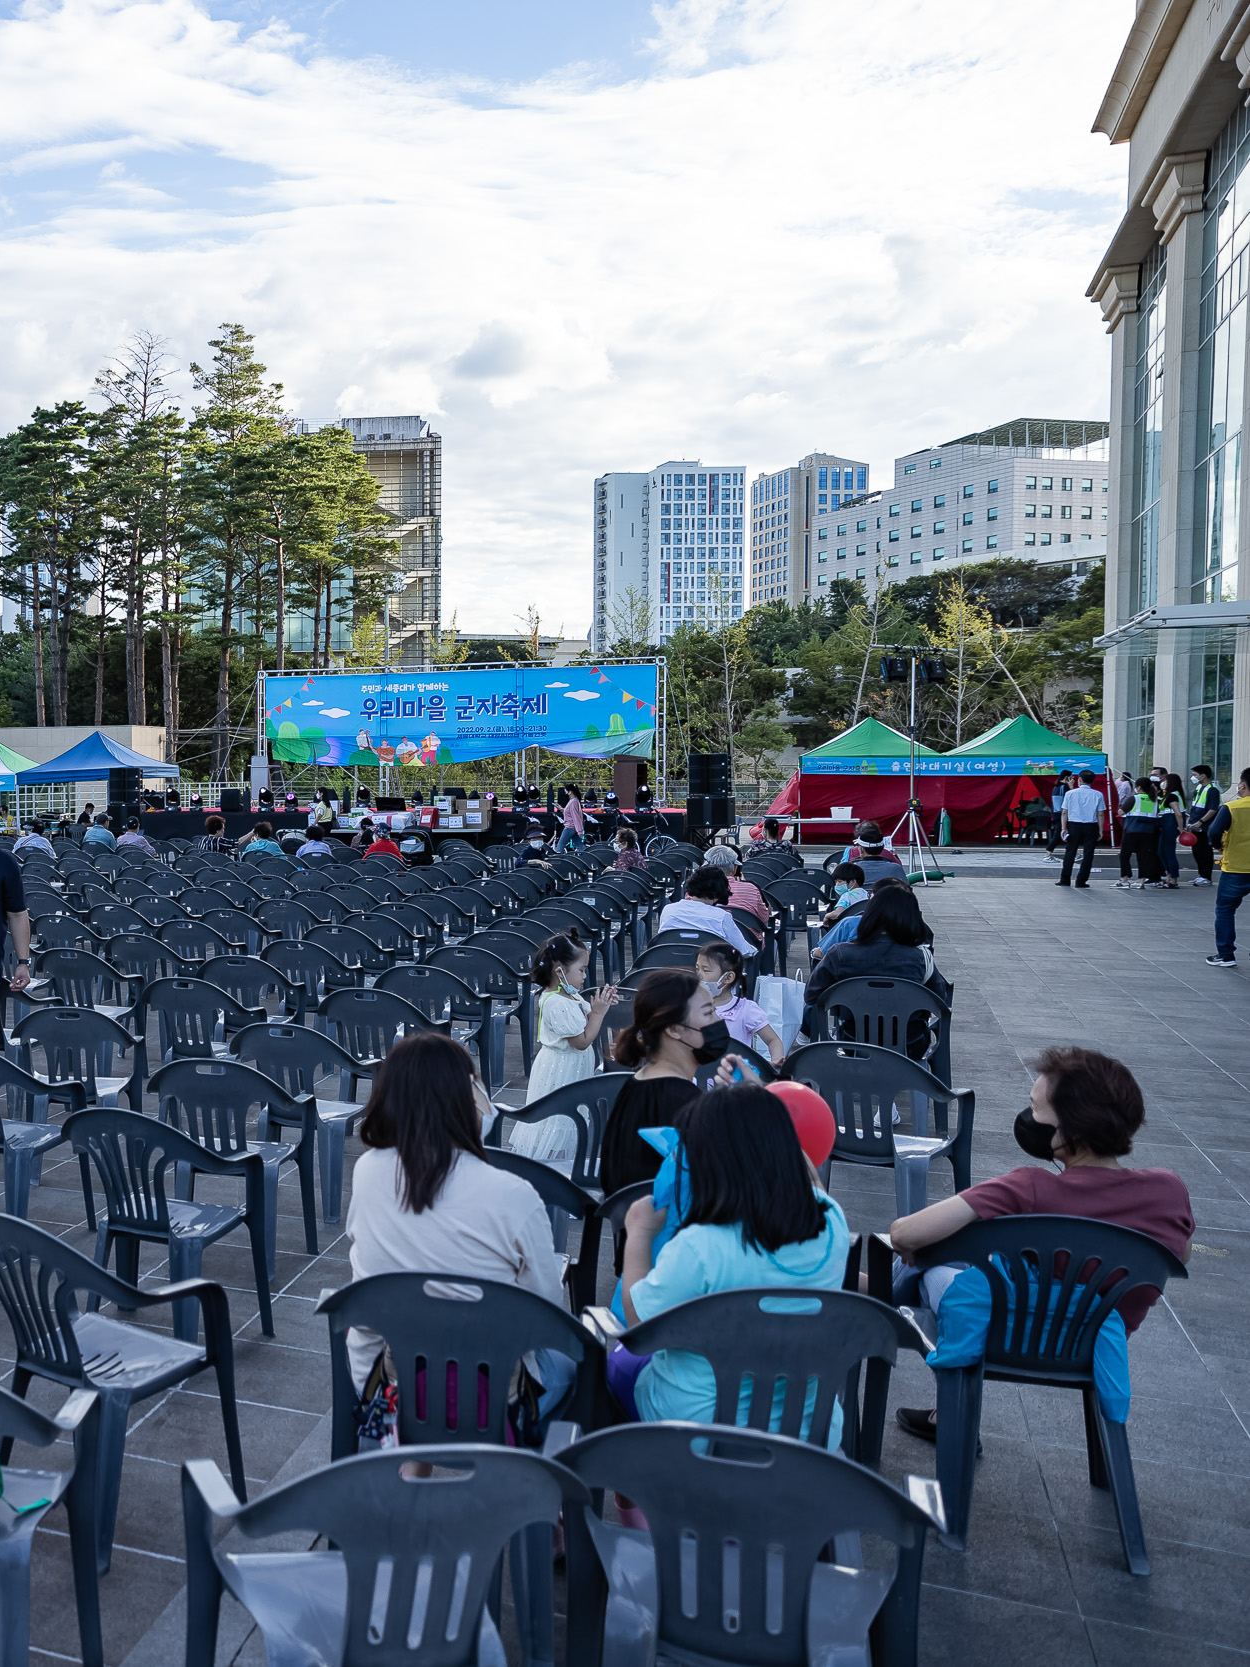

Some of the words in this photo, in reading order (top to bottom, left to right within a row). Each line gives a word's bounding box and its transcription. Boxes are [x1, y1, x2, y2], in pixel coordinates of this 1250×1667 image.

[360, 684, 382, 693] 주민과
[384, 683, 415, 693] 세종대가
[417, 682, 449, 692] 함께하는
[359, 694, 448, 722] 우리마을
[454, 692, 548, 721] 군자축제
